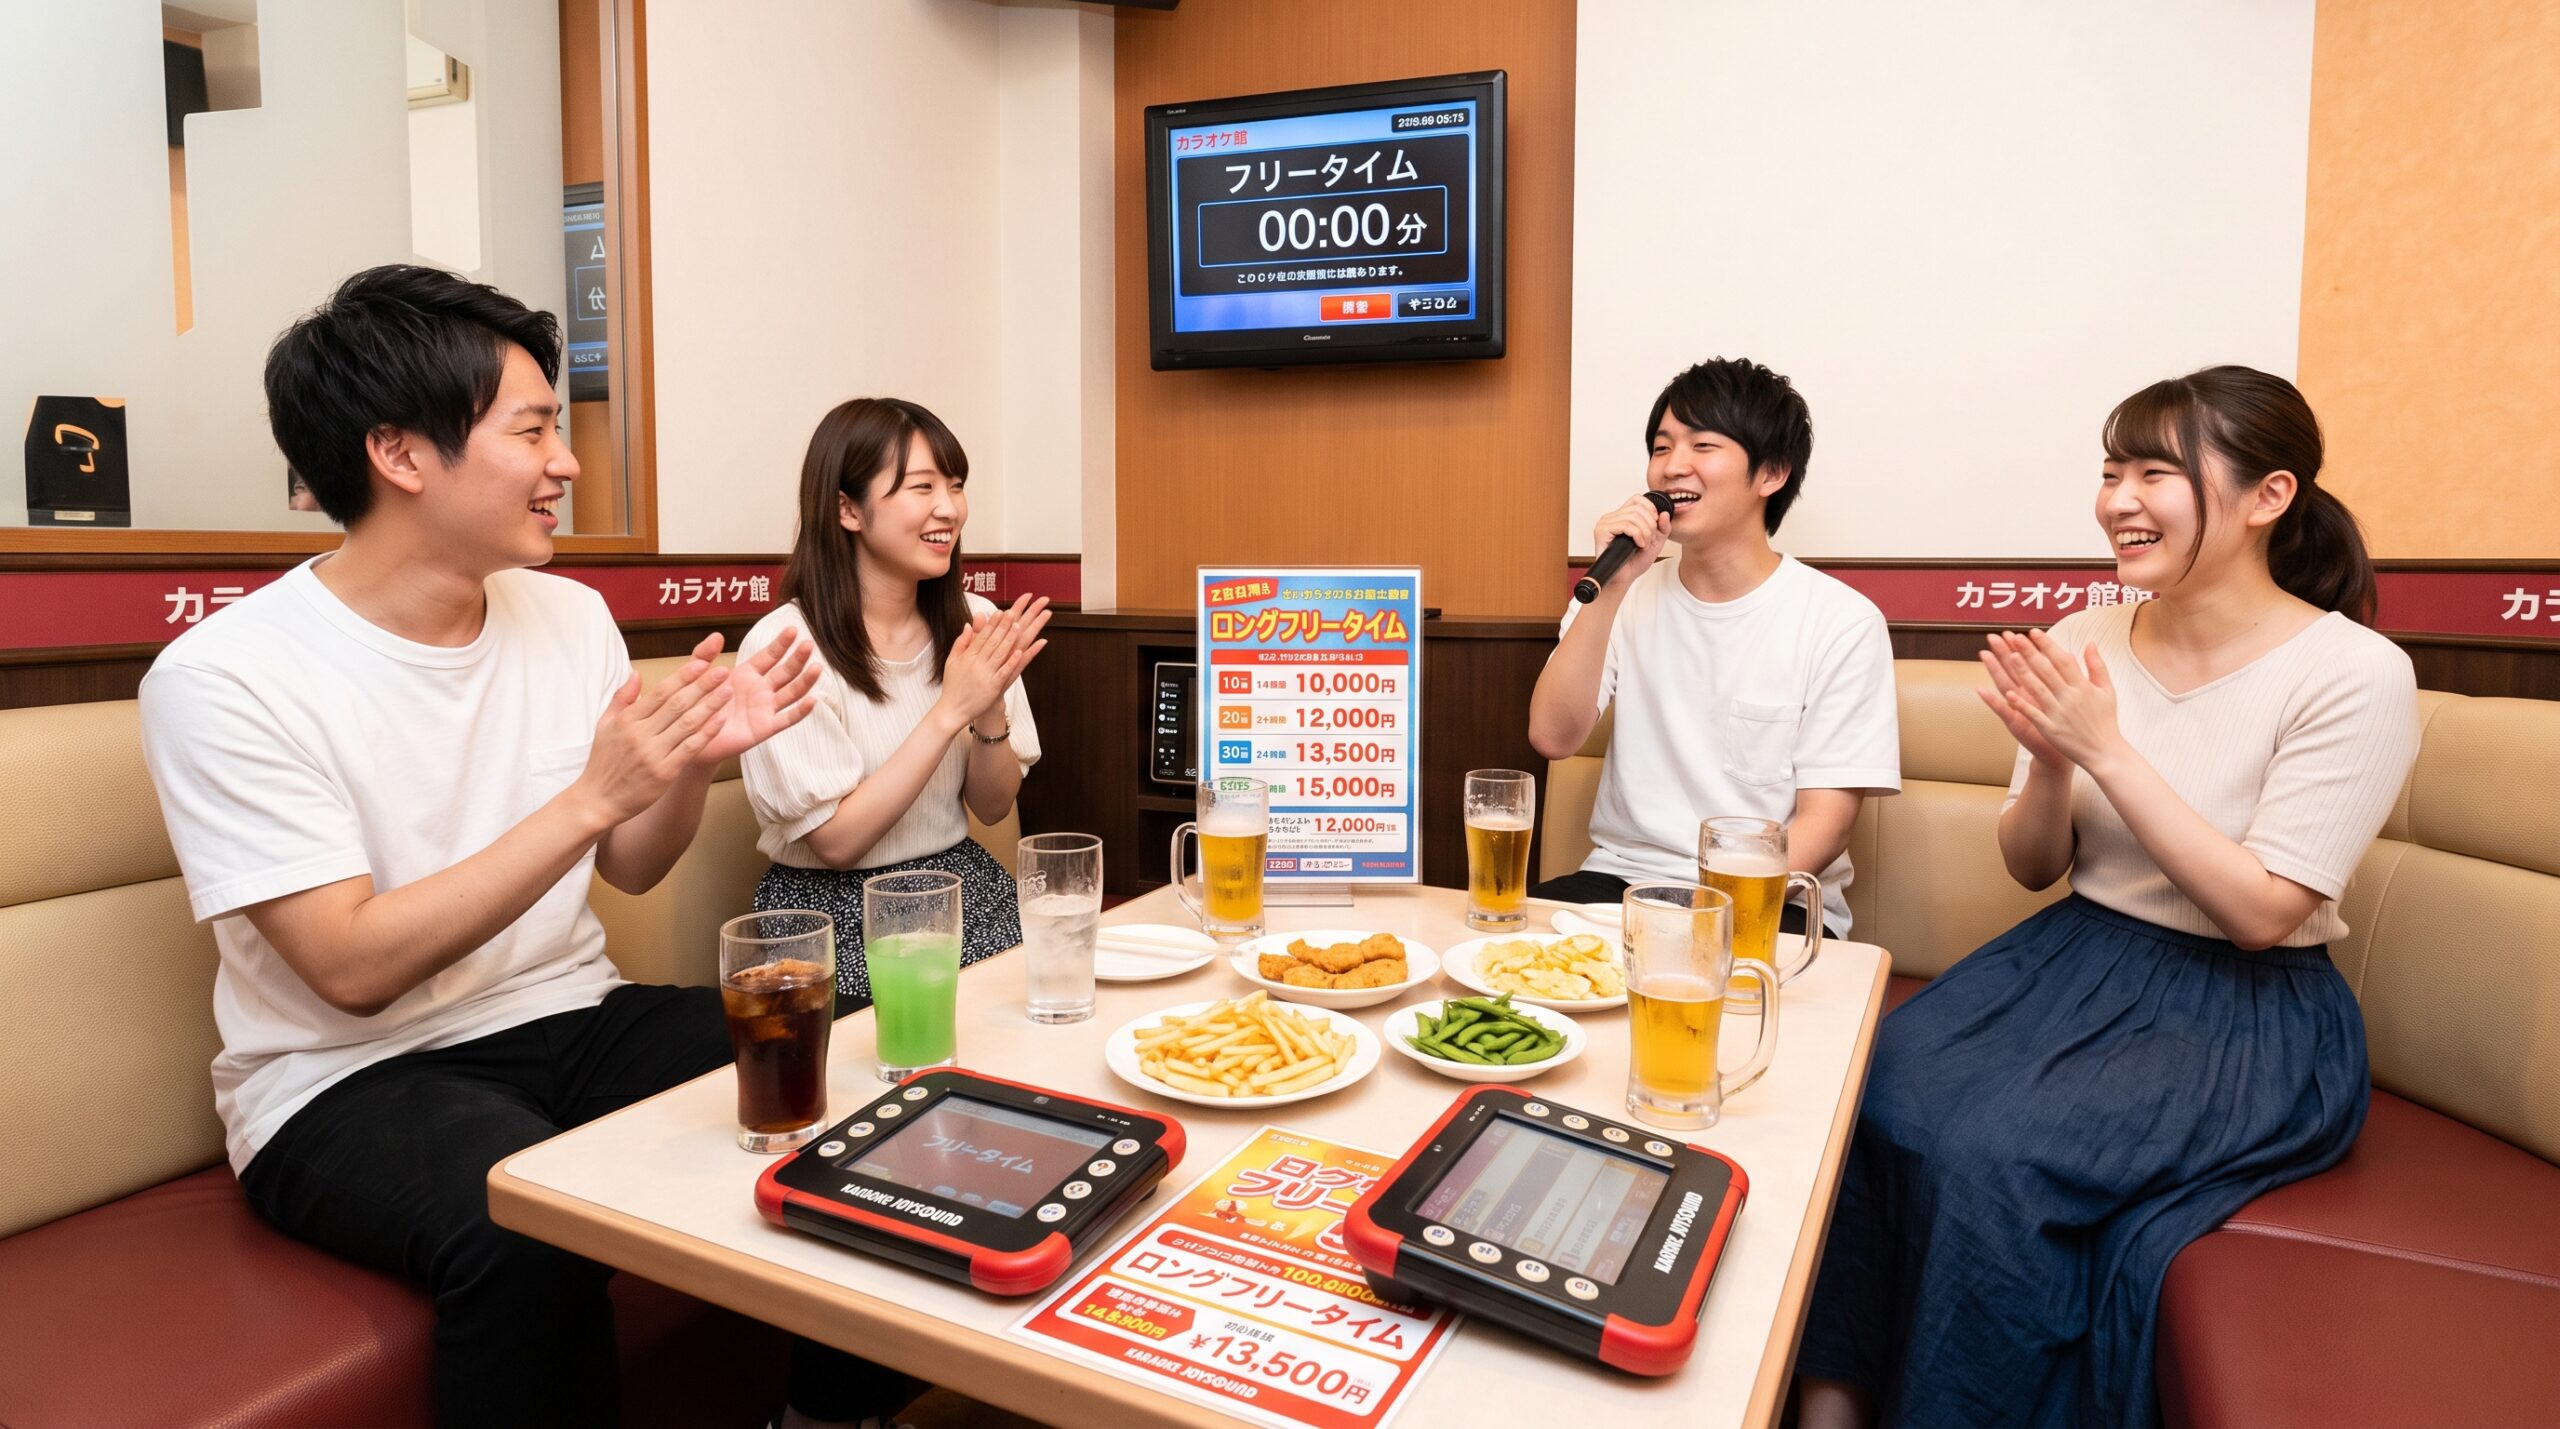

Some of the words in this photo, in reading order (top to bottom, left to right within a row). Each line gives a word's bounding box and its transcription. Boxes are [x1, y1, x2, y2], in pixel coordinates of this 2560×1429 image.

[1177, 130, 1248, 151] カラオケ館
[1225, 149, 1419, 194] フリータイム
[658, 575, 771, 605] カラオケ館
[1210, 608, 1409, 643] ロングフリータイム
[1296, 672, 1395, 696] 10,000円
[1296, 707, 1395, 731] 12,000円
[1296, 742, 1395, 765] 13,500円
[1296, 776, 1395, 799] 15,000円
[1314, 817, 1385, 834] 12,000円
[1126, 1251, 1406, 1353] ロングフリータイム
[1125, 1347, 1182, 1374] KARAOKE
[1180, 1362, 1259, 1400] JOYSOUND
